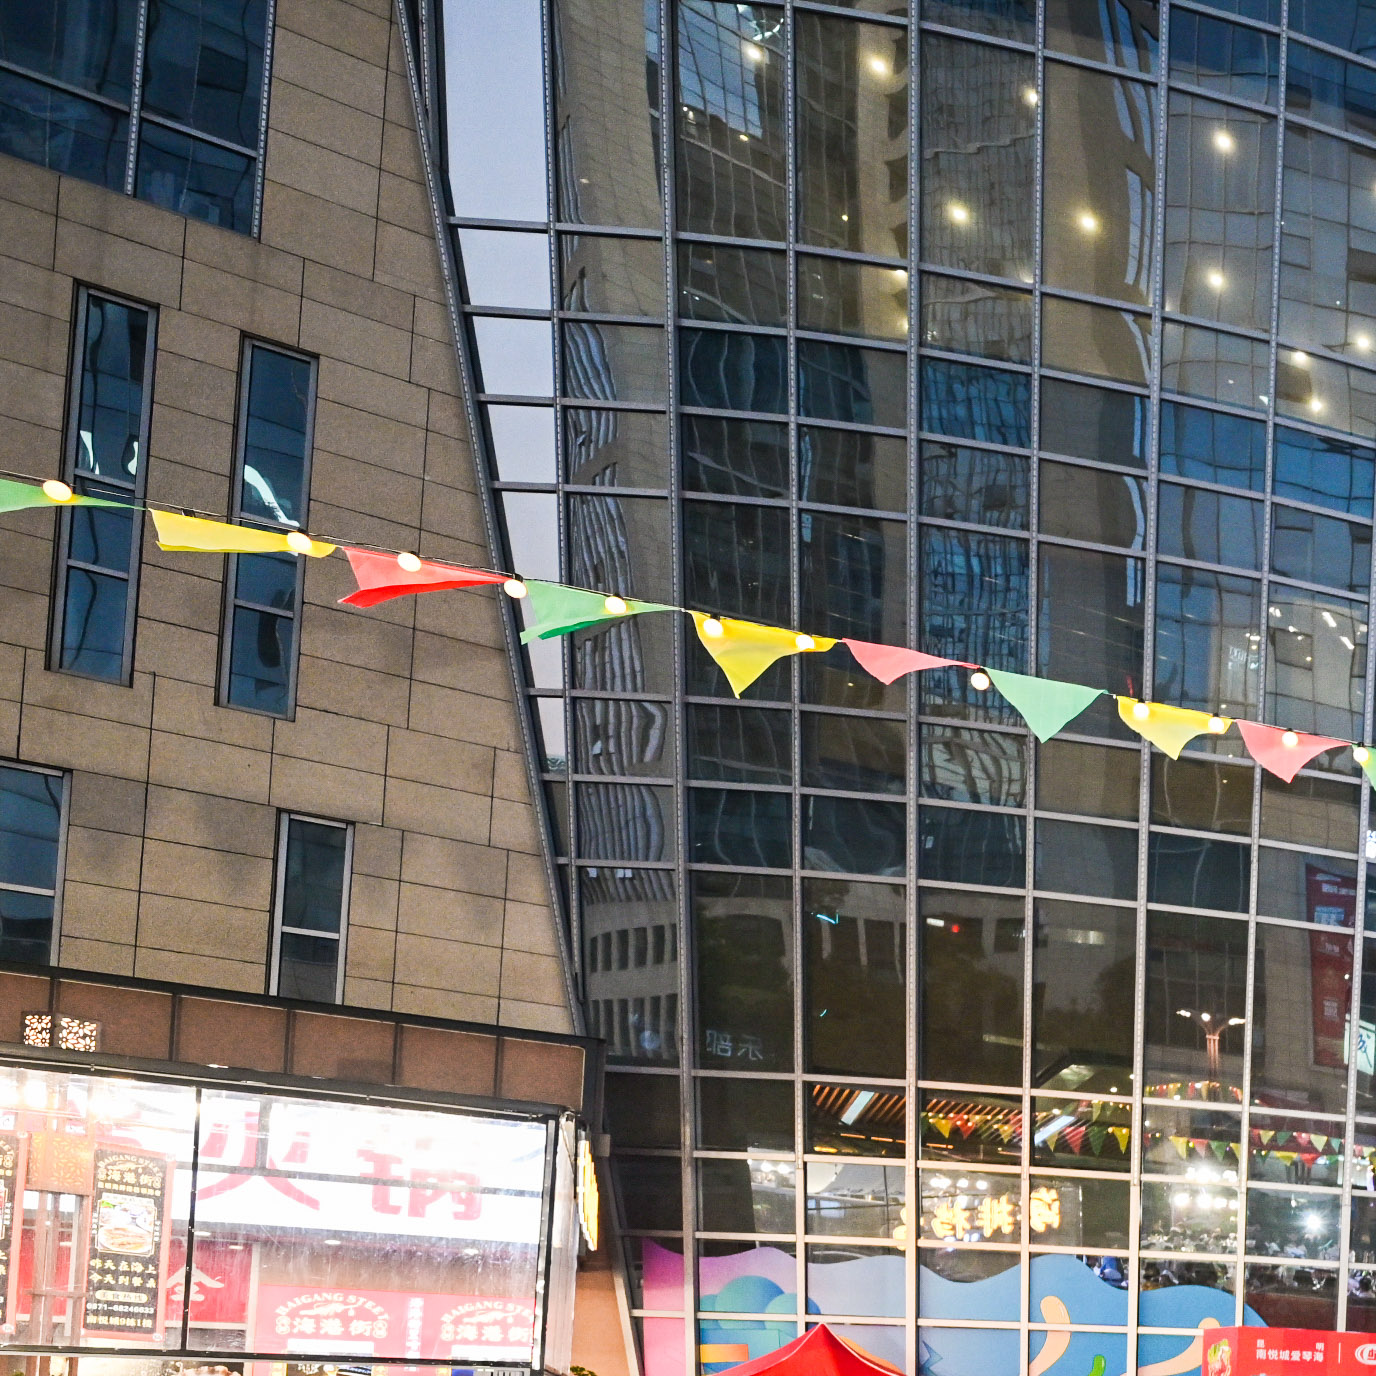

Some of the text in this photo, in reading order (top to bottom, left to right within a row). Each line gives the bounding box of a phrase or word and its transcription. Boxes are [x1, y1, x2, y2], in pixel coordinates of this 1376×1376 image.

[1256, 1348, 1325, 1363] 南悦城爱琴海
